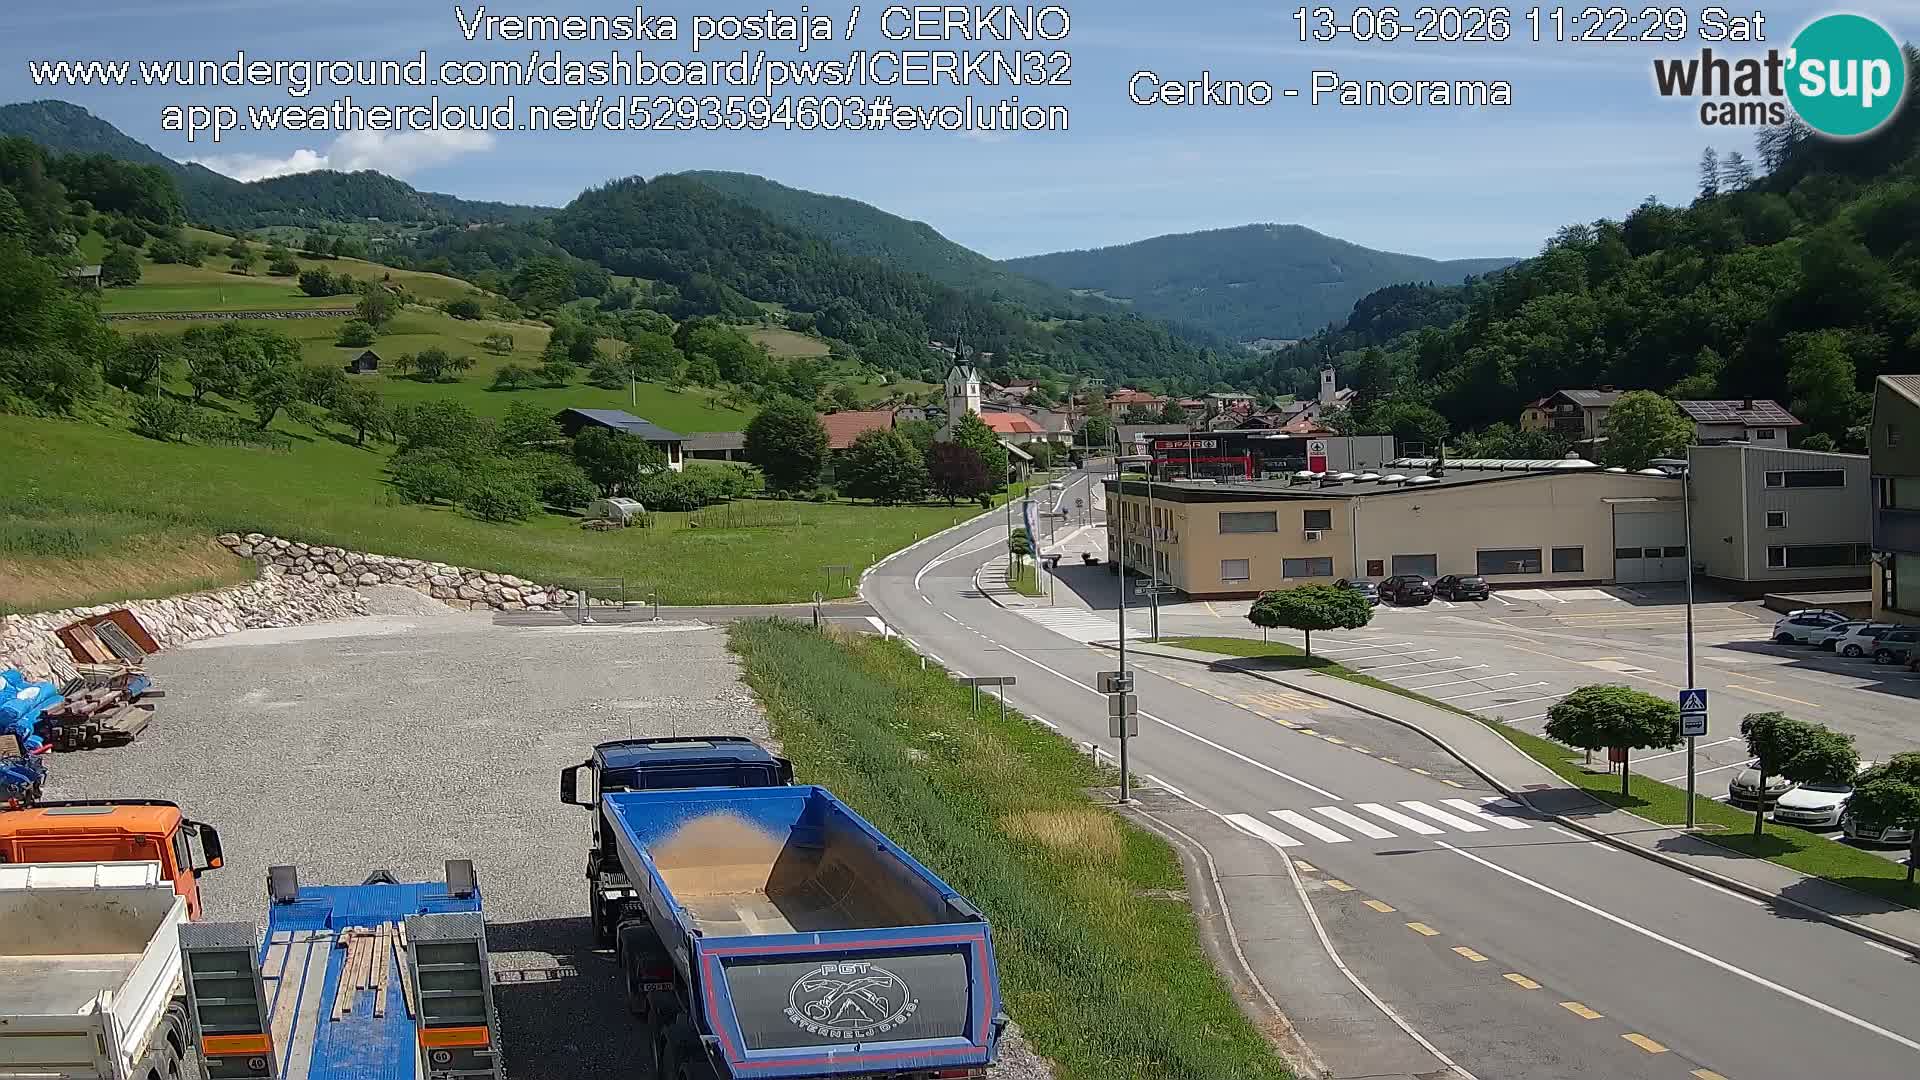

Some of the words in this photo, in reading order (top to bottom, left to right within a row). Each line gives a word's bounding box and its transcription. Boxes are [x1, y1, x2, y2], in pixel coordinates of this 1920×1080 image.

[1165, 441, 1201, 449] SPAR
[821, 962, 870, 976] PGT
[783, 1007, 875, 1038] PETERNELJ
